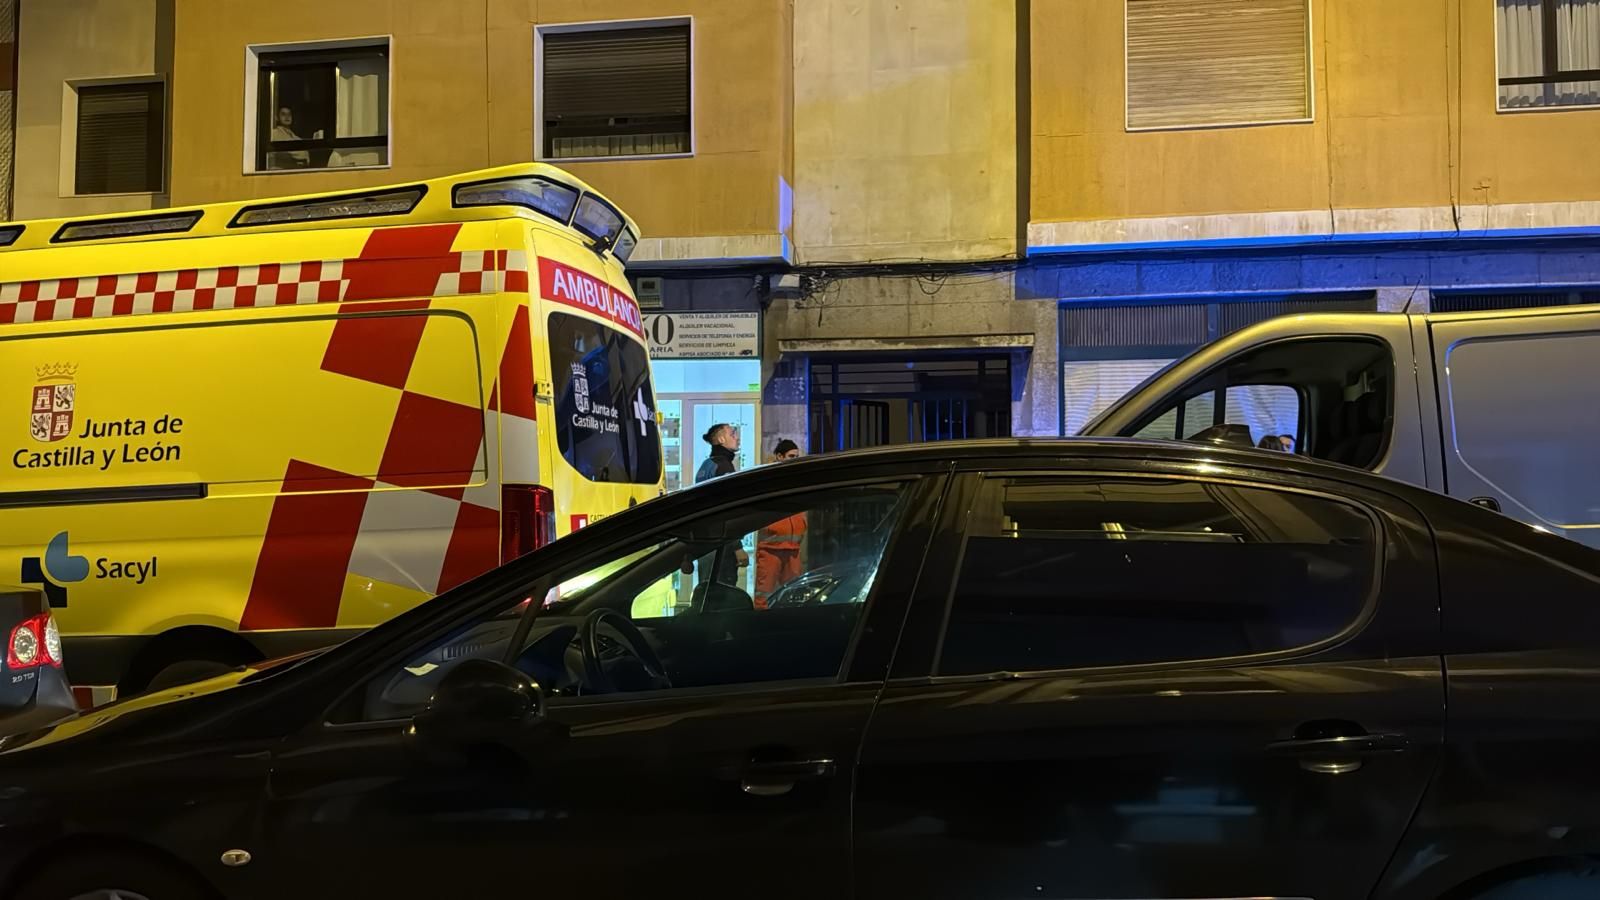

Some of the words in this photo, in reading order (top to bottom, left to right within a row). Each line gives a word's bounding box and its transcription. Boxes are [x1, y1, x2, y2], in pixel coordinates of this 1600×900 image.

[592, 401, 610, 416] Junta
[611, 405, 618, 418] de
[79, 418, 146, 438] Junta
[153, 415, 183, 434] de
[572, 413, 599, 430] Castilla
[600, 420, 604, 434] y
[605, 418, 620, 433] León
[13, 446, 95, 469] Castilla
[100, 448, 116, 470] y
[122, 442, 181, 463] León
[95, 557, 157, 584] Sacyl
[23, 672, 35, 681] TDI
